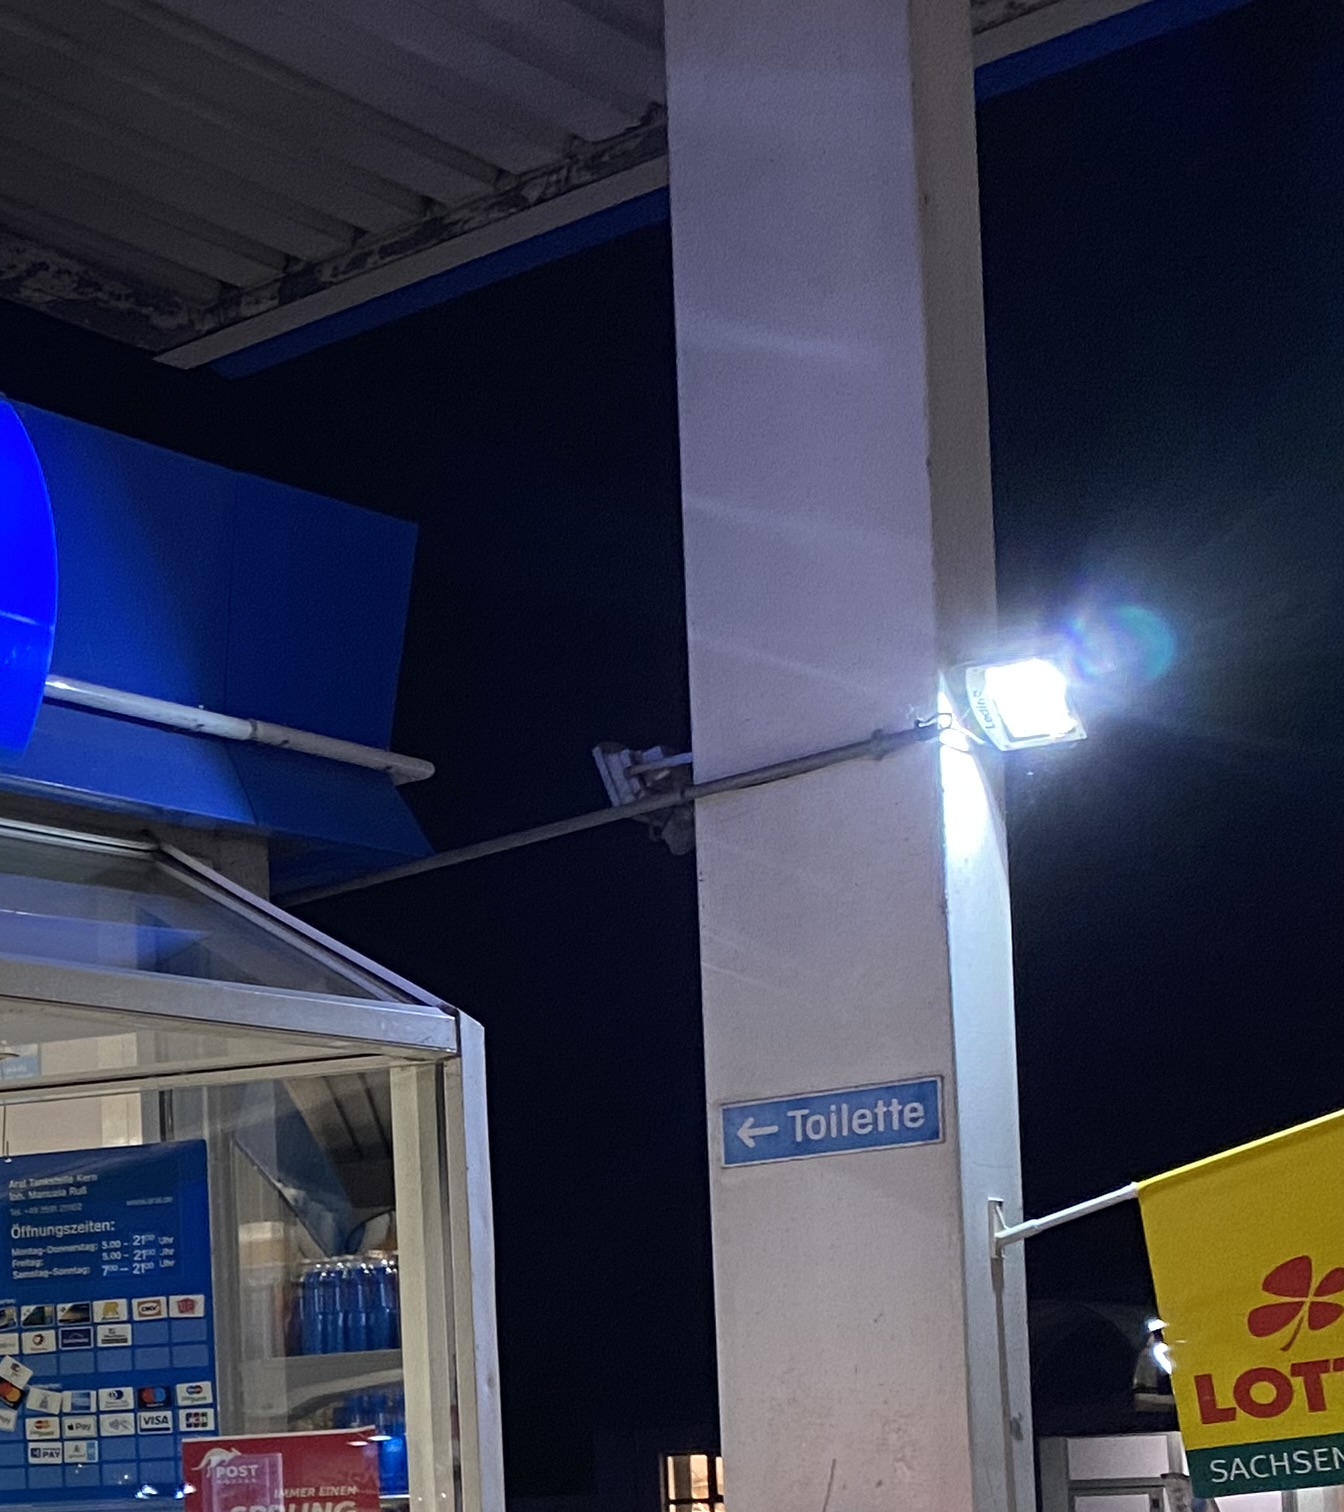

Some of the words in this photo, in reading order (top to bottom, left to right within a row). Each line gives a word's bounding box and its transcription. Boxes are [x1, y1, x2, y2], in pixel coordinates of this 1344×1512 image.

[787, 1098, 925, 1142] Toilette
[11, 1220, 115, 1239] Öffnungszeiten:
[1194, 1357, 1344, 1425] LOT
[75, 1422, 91, 1432] Pay
[143, 1415, 169, 1426] VISA
[42, 1451, 61, 1459] PAY
[216, 1464, 259, 1479] POST
[274, 1487, 315, 1499] IMMER
[318, 1485, 358, 1497] EINEN
